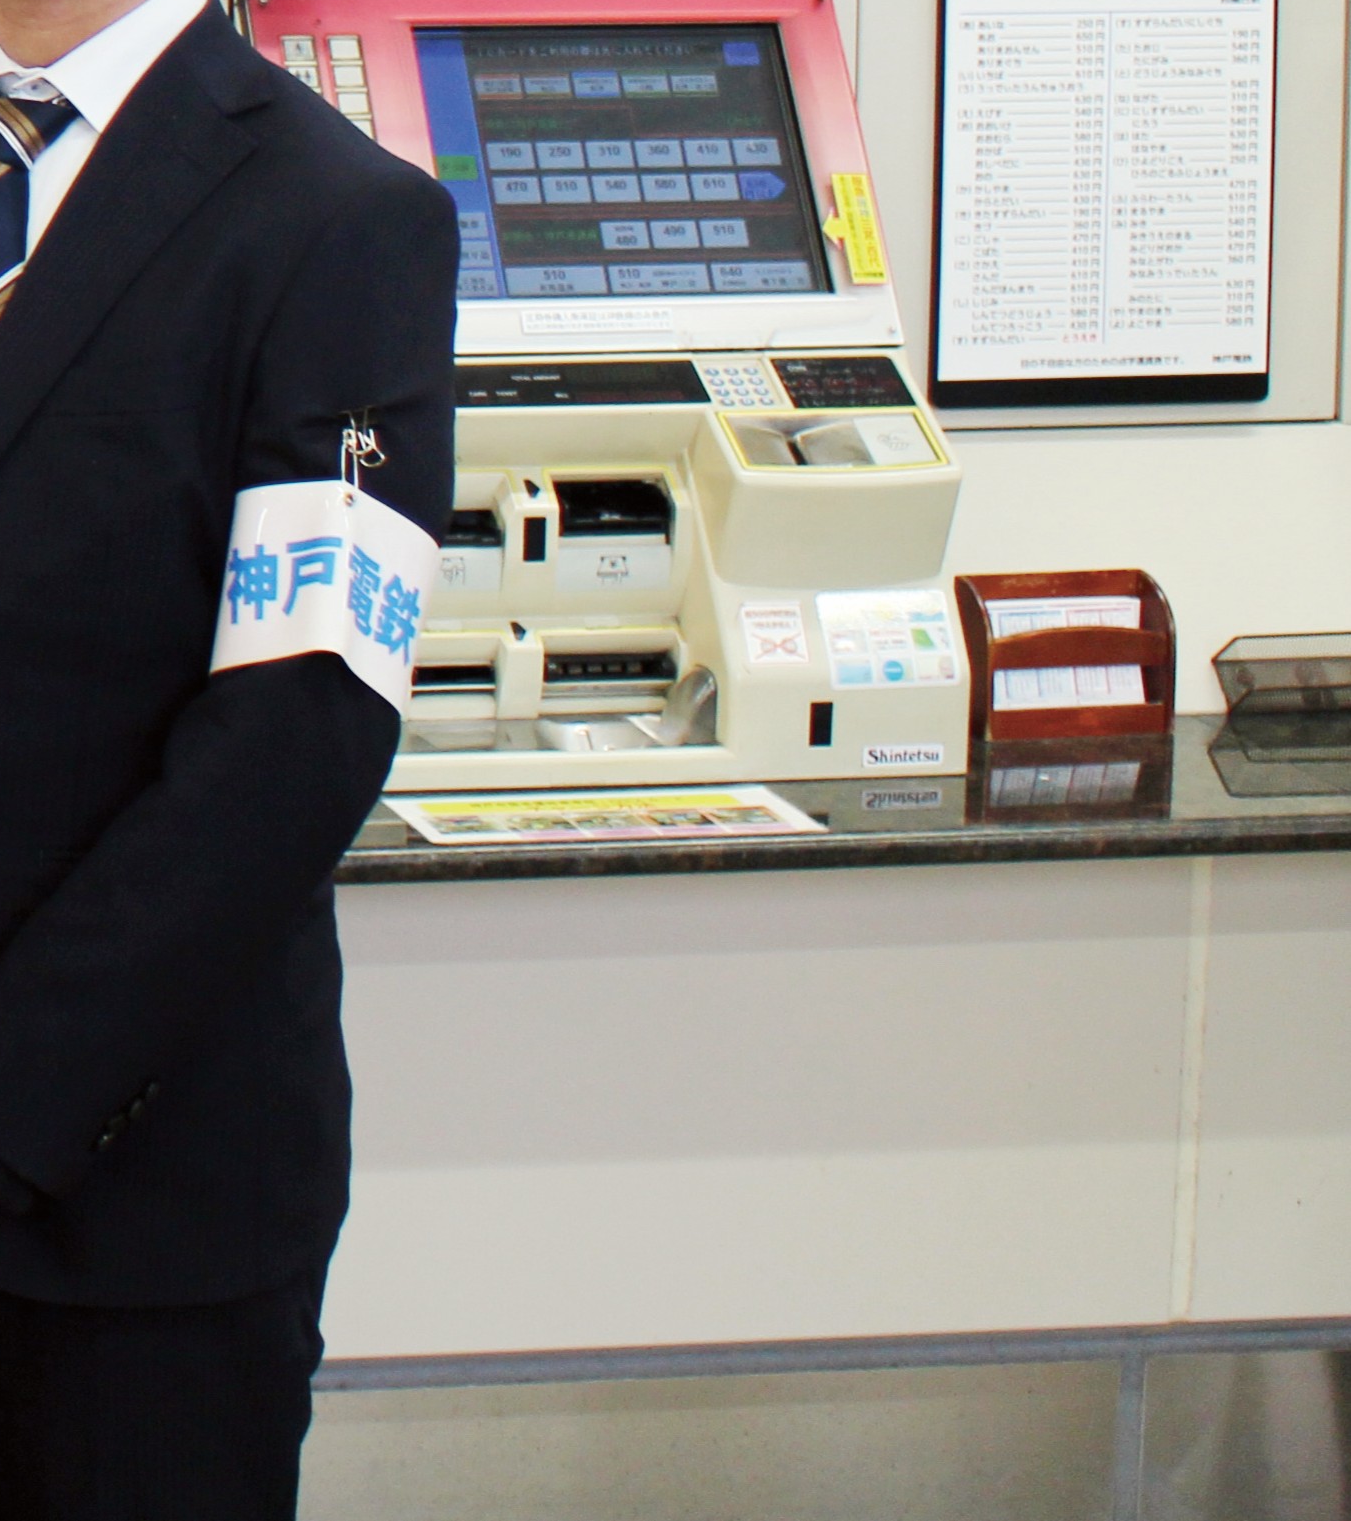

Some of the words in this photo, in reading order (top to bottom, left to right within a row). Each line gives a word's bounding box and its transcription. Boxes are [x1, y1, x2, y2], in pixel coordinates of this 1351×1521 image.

[227, 536, 421, 665] 神戸電鉄
[867, 749, 940, 765] Shintetsu
